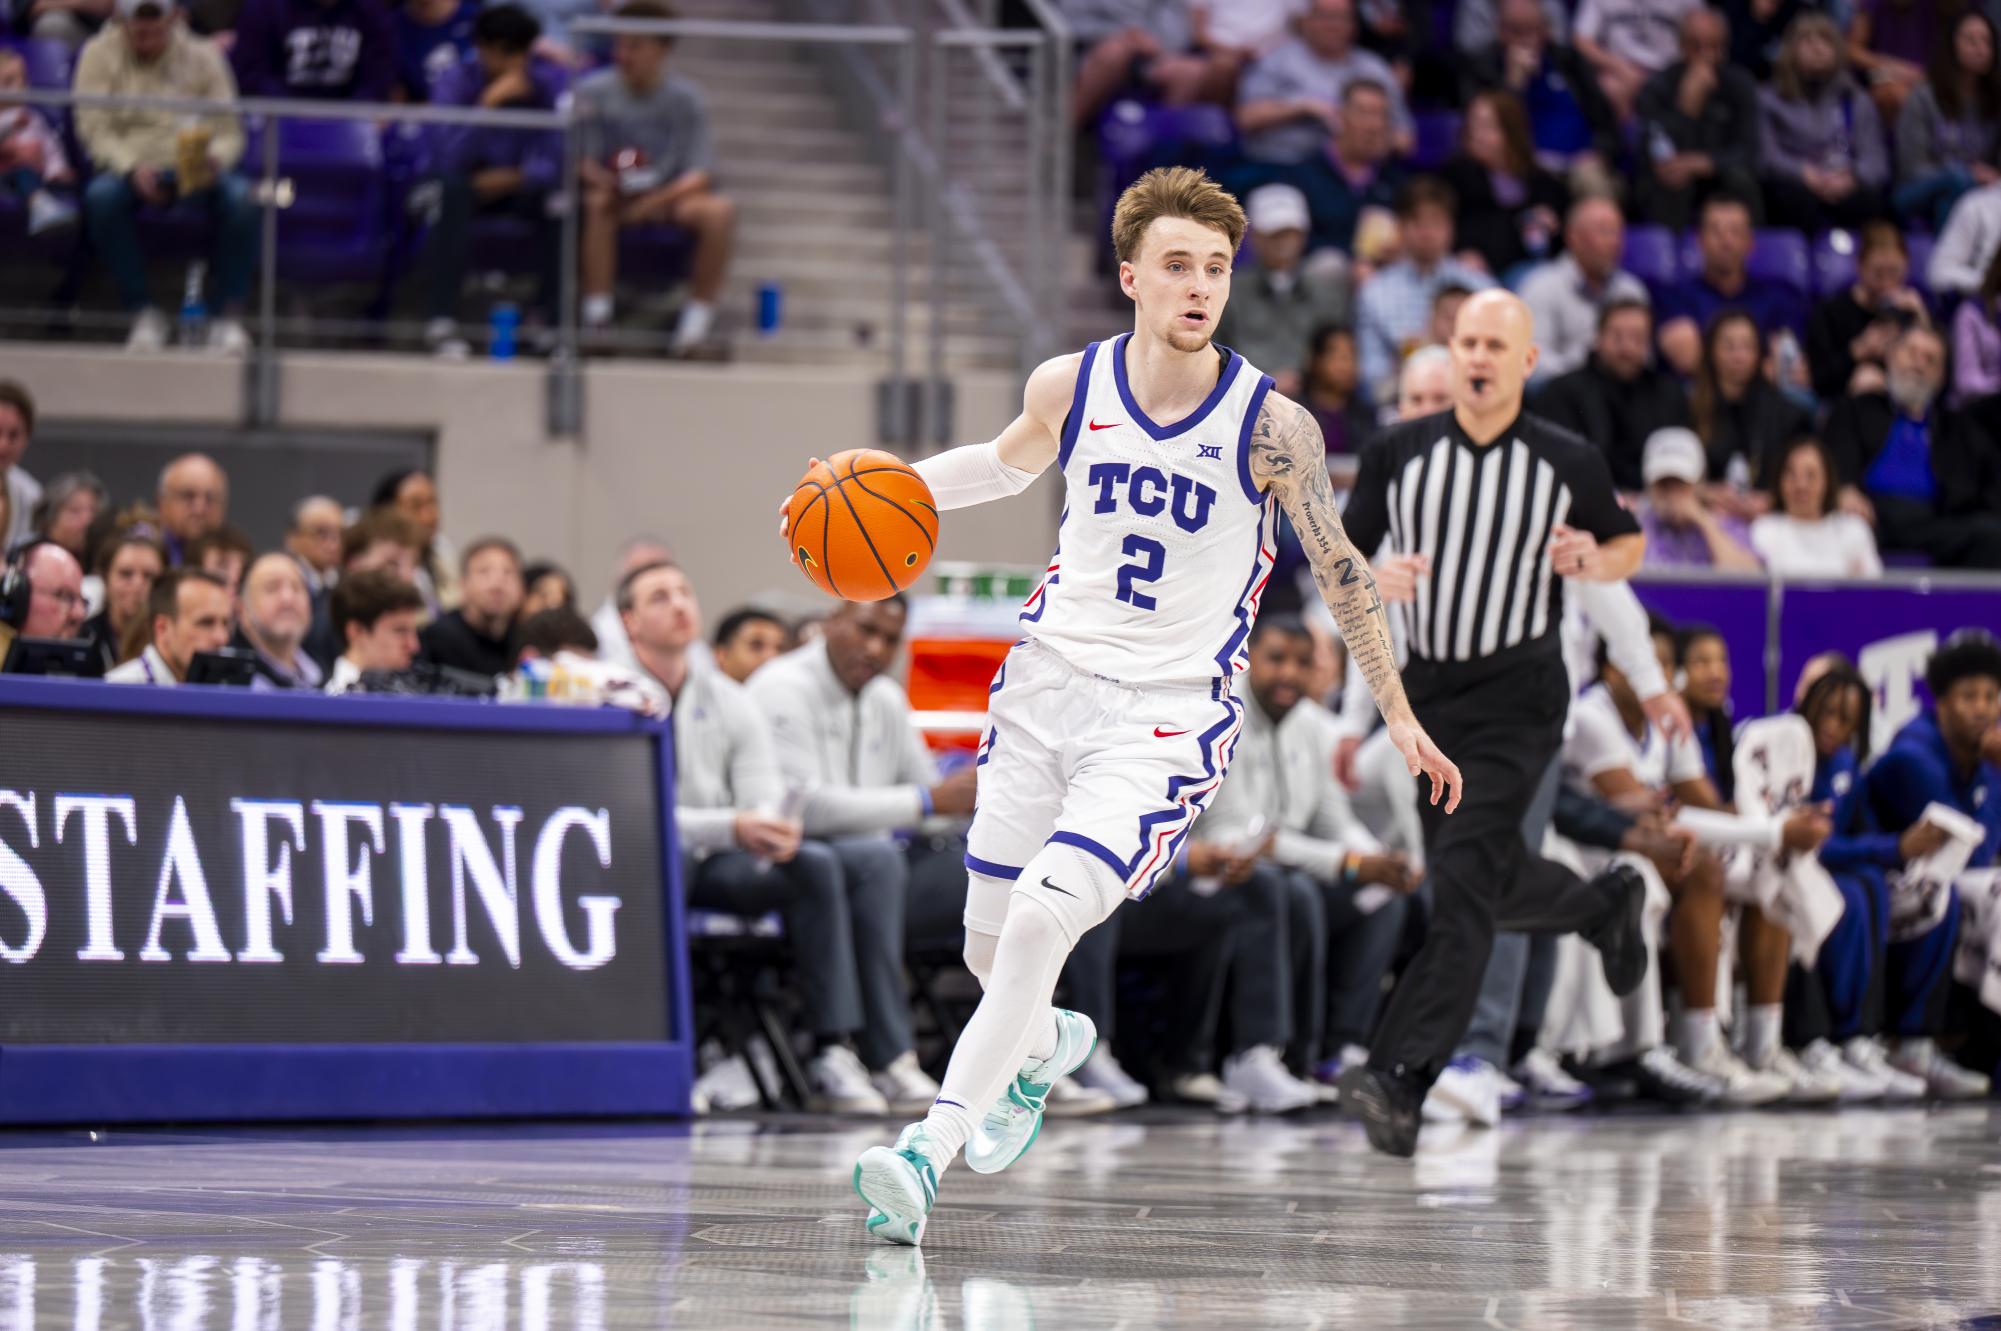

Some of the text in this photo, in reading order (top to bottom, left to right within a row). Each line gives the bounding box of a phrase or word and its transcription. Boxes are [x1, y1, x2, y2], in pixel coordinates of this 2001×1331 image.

[1195, 443, 1223, 461] XII
[1088, 462, 1217, 534] TCU
[1302, 501, 1321, 537] Proverbs
[1115, 533, 1167, 611] 2
[1333, 557, 1360, 587] 2
[0, 790, 622, 970] STAFFING
